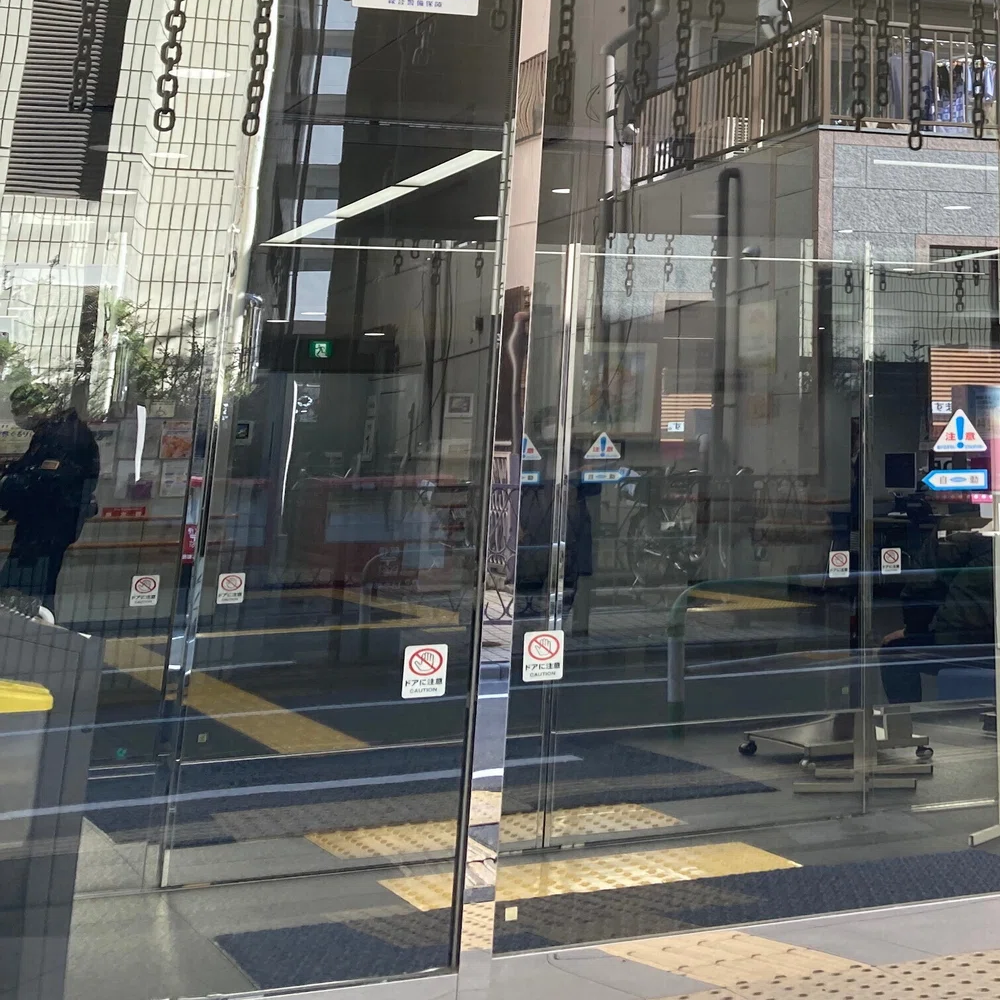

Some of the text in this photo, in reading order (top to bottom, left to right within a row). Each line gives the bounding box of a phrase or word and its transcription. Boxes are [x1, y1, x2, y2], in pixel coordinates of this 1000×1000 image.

[525, 661, 561, 671] ドアに注意
[529, 670, 557, 678] CAUTION
[404, 677, 443, 687] ドアに注意
[409, 686, 438, 695] CAUTION
